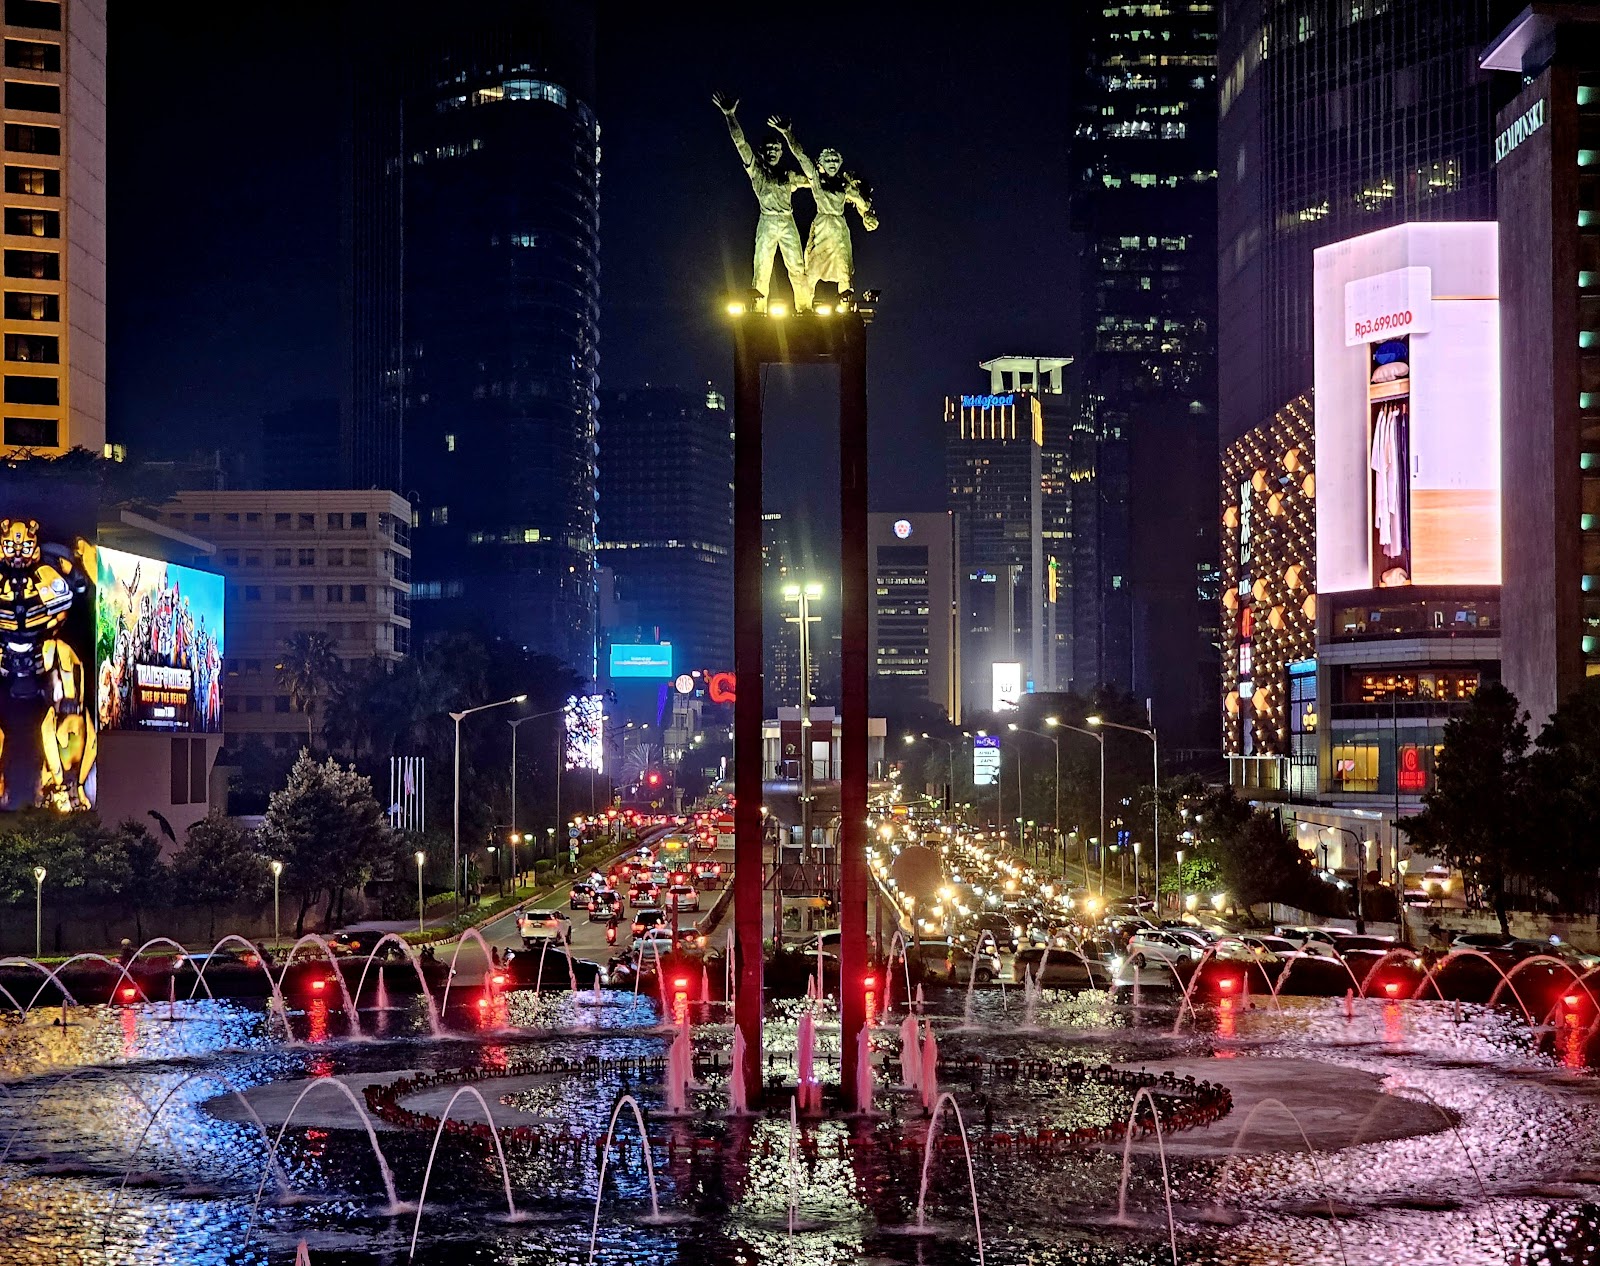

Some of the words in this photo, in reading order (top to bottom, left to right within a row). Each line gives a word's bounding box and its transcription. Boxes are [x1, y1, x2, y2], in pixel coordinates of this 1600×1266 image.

[1495, 98, 1545, 164] KEMPINSKI
[1354, 310, 1413, 340] Rp3.699.000
[136, 664, 192, 691] TRANSFORMERS
[141, 690, 153, 703] RISE
[153, 691, 160, 704] OF
[161, 692, 170, 704] THE
[170, 693, 187, 705] BEASTS
